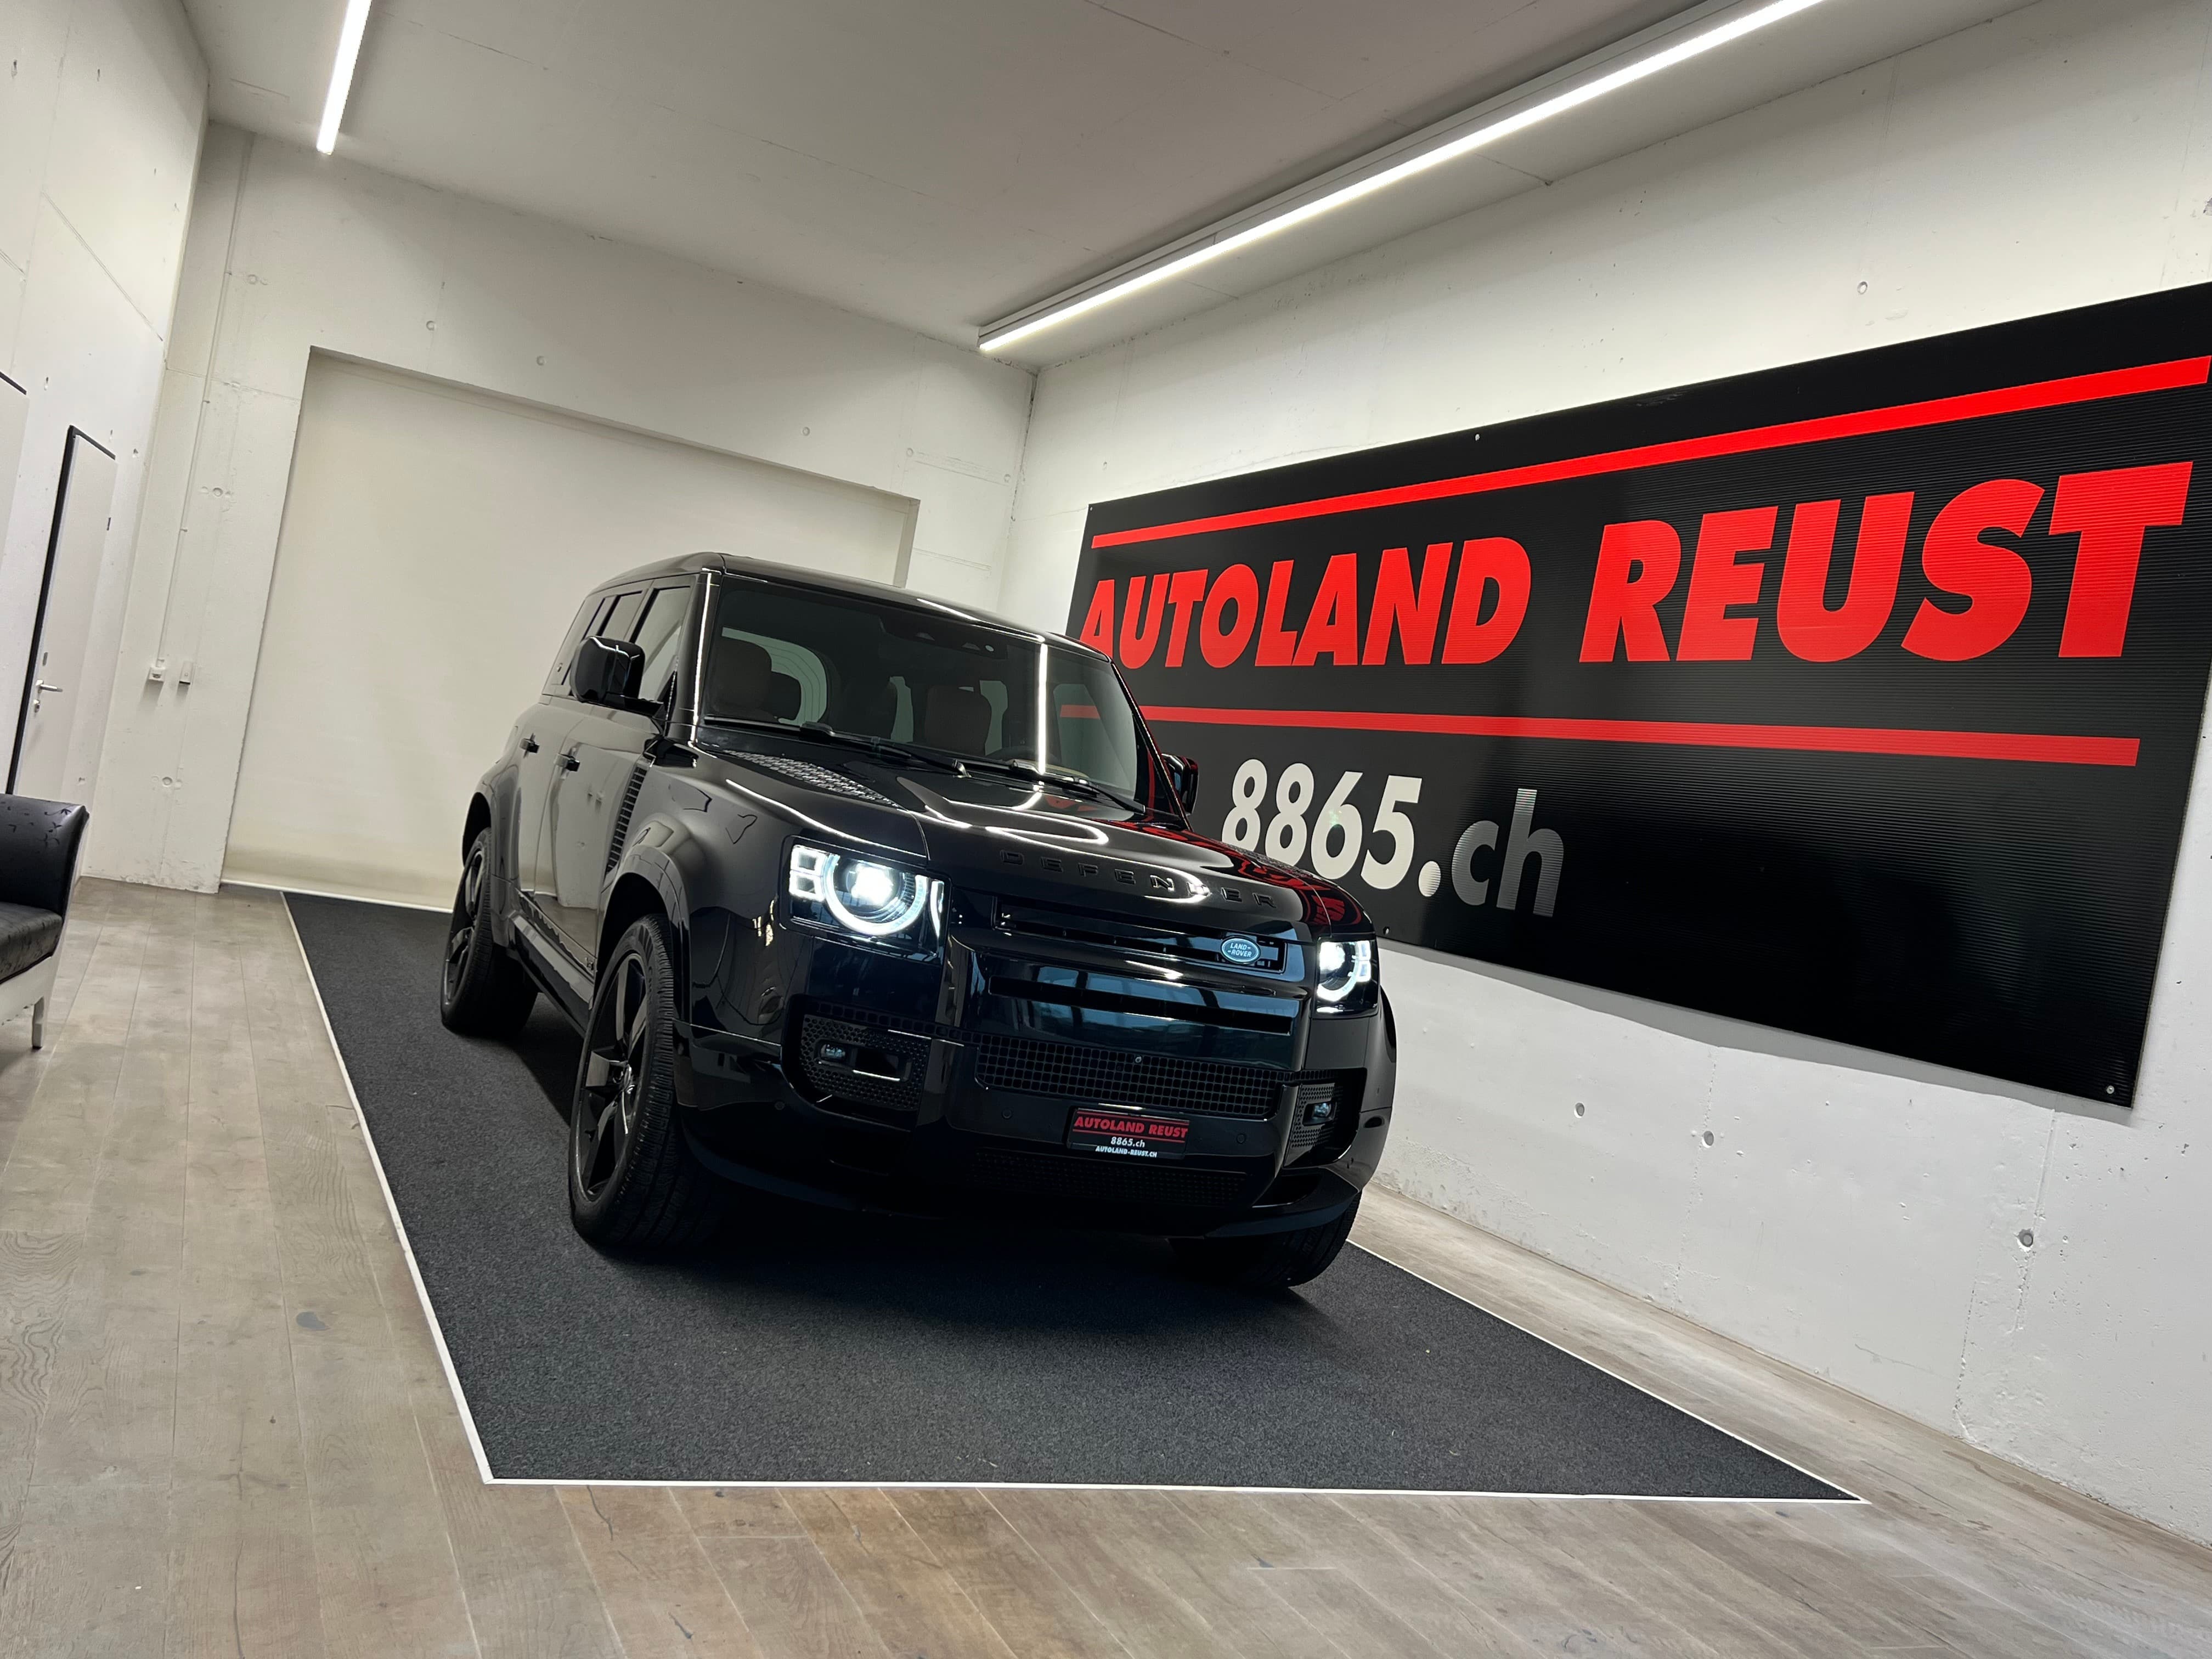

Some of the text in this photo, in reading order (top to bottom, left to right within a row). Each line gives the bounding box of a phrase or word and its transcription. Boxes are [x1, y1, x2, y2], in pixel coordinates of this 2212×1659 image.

[1079, 461, 2193, 669] AUTOLAND REUST
[1222, 759, 1564, 917] 8865.ch
[1074, 1116, 1188, 1138] AUTOLAND REUST
[1095, 1146, 1157, 1158] AUTOLAND-REUST.CH
[1110, 1137, 1146, 1148] 8865.ch
